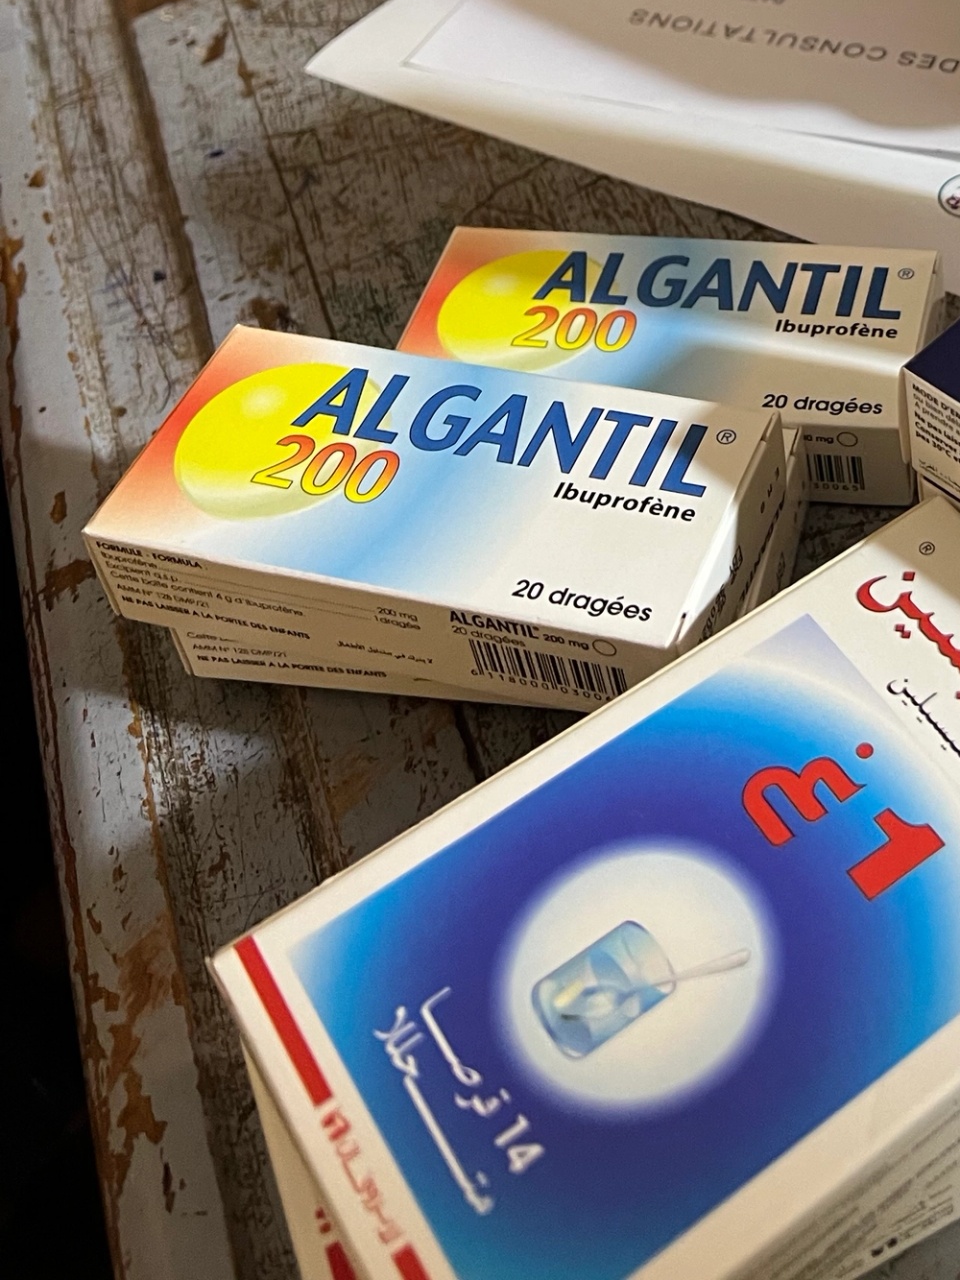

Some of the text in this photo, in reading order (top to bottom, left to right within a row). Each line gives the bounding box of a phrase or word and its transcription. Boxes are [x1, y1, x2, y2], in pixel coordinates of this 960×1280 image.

[627, 7, 888, 64] CONSULTATIONS
[897, 50, 960, 75] DES
[533, 251, 901, 320] ALGANTIL
[511, 305, 638, 352] 200
[775, 318, 898, 341] Ibuprofène
[761, 393, 883, 416] 20 dragées
[912, 382, 938, 406] MODE
[290, 366, 709, 499] ALGANTIL
[914, 410, 924, 423] Ne
[927, 420, 941, 435] pas
[915, 421, 956, 453] Conserver
[251, 433, 401, 505] 200
[553, 481, 697, 523] Ibuprofène
[96, 540, 202, 569] FORMULE FORMULA
[170, 583, 212, 598] contient
[226, 595, 232, 603] g
[511, 579, 654, 623] 20 dragées
[136, 598, 153, 607] PAS
[155, 602, 189, 614] LAISSER
[201, 611, 212, 619] LA
[215, 614, 246, 626] PORTEE
[250, 621, 267, 630] DES
[270, 625, 310, 639] ENFANTS
[376, 606, 417, 622] 200 mg
[449, 609, 588, 651] ALGANTIL 200 mg
[452, 624, 525, 648] 20 dragées
[211, 655, 229, 663] PAS
[278, 661, 289, 669] LA
[292, 661, 324, 673] PORTEE
[326, 665, 343, 674] DES
[346, 666, 387, 679] ENFANTS
[846, 807, 946, 902] 1
[495, 1114, 545, 1173] 14
